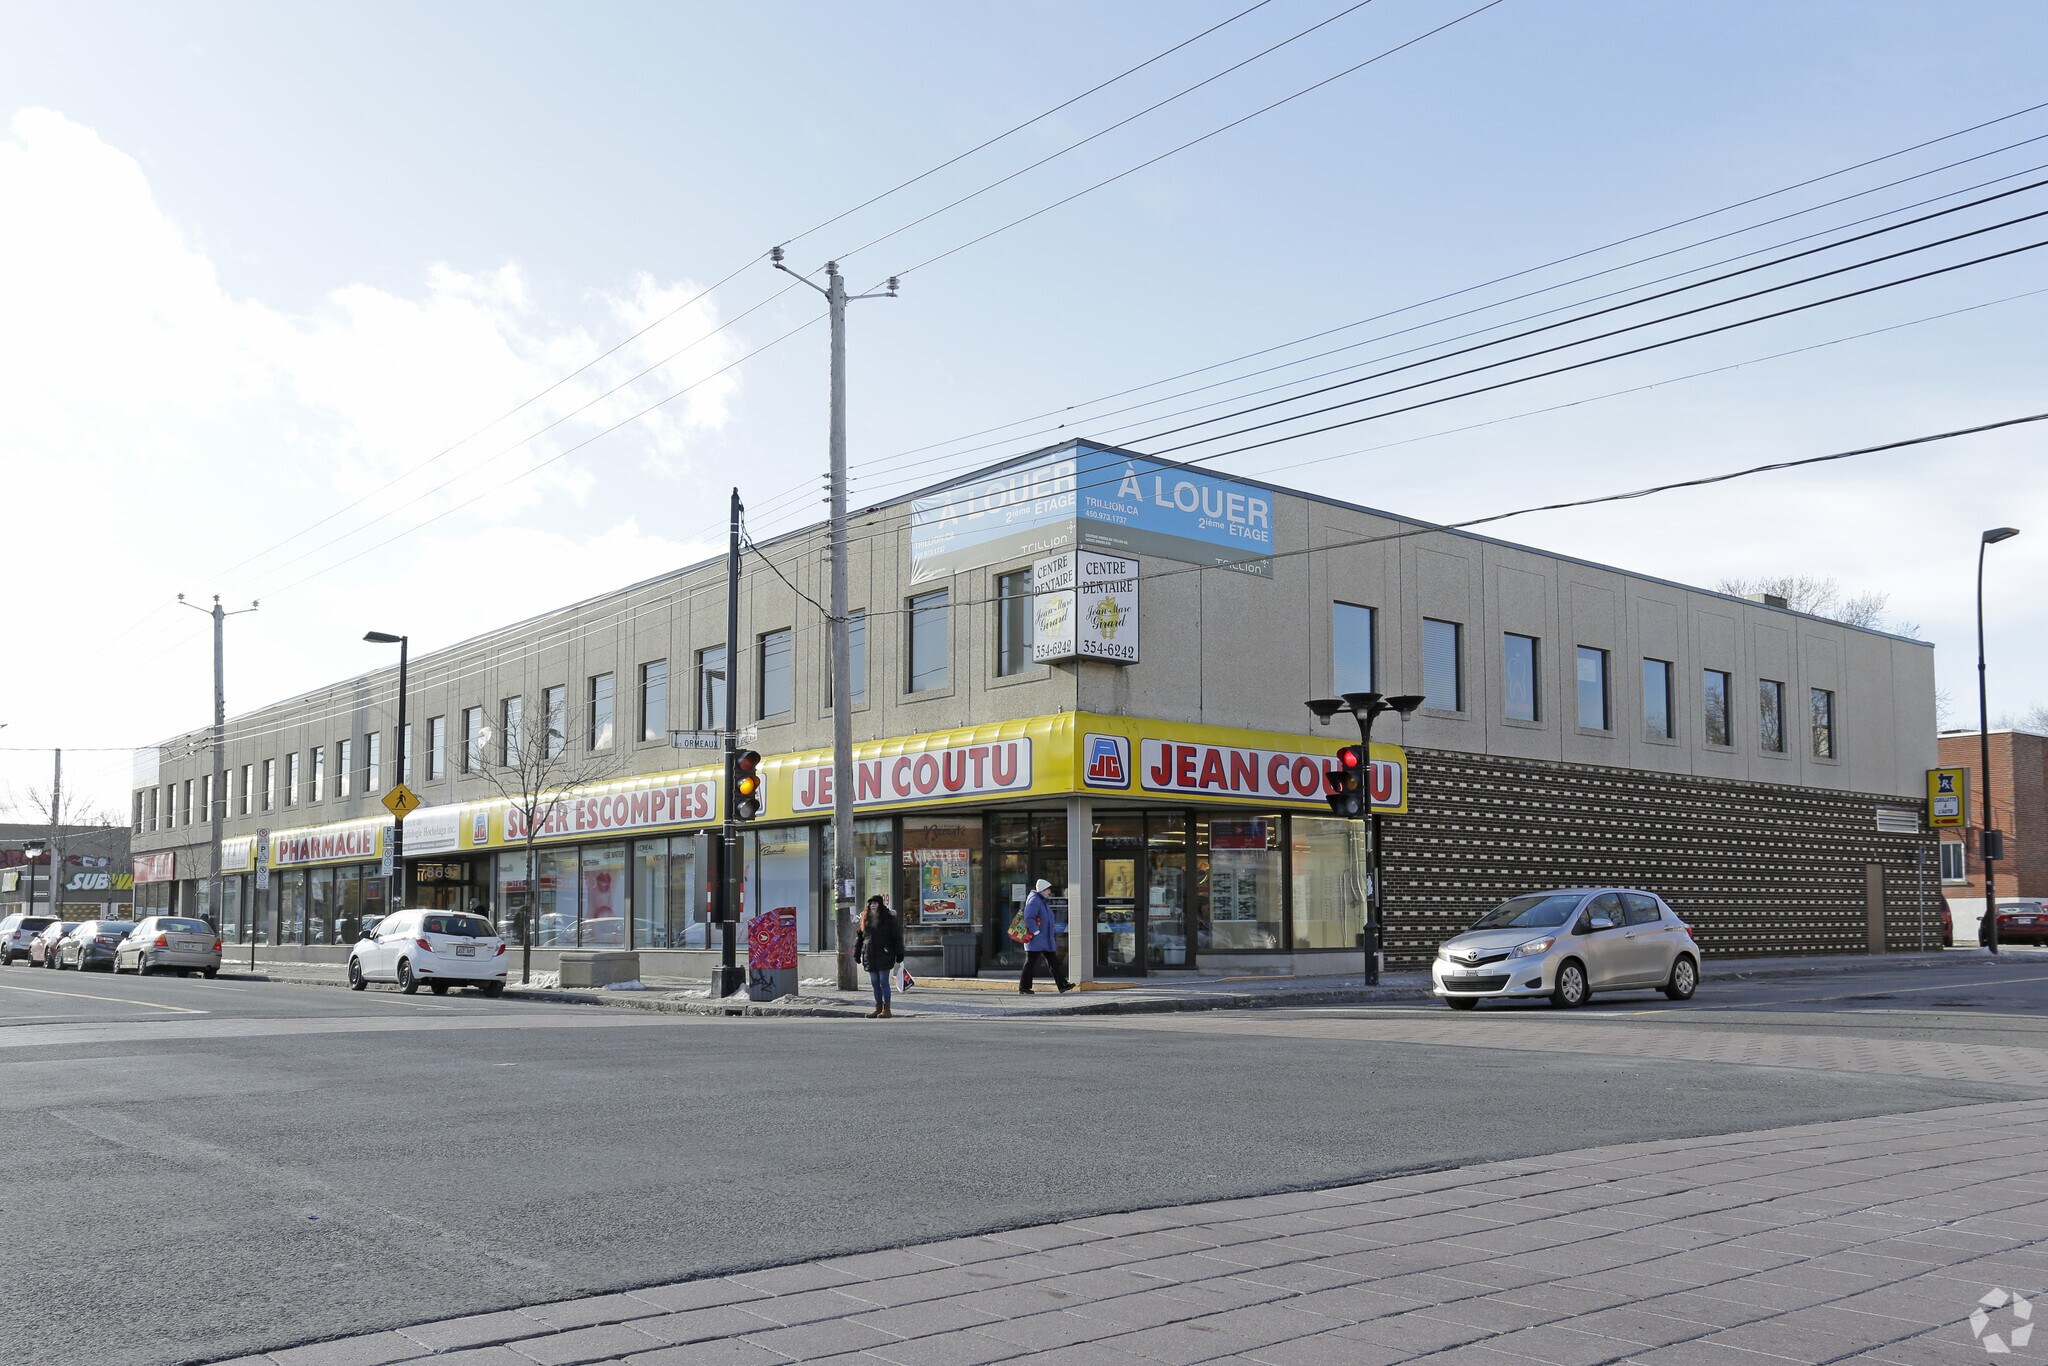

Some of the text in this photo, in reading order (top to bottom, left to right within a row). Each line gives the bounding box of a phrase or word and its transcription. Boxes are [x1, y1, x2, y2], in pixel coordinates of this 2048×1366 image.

[968, 460, 1076, 520] LOUER
[1117, 461, 1269, 529] À LOUER
[1005, 493, 1076, 523] 2ième ÉTAGE
[1085, 496, 1139, 516] TRILLION.CA
[1085, 509, 1127, 524] 450.973.1737
[1198, 518, 1269, 543] 2ième ÉTAGE
[1037, 555, 1068, 579] CENTRE
[1086, 561, 1126, 575] CENTRE
[1035, 569, 1073, 597] DENTAIRE
[1082, 580, 1133, 594] DENTAIRE
[1039, 607, 1069, 631] Girard
[1085, 604, 1131, 620] Jean-Marc
[1090, 614, 1127, 630] Girard
[1035, 639, 1071, 658] 354-6242
[1083, 640, 1134, 659] 354-6242
[684, 739, 718, 748] ORMEAUX
[801, 743, 1018, 807] JEN COUTU
[1151, 743, 1392, 802] JEAN COUU
[508, 783, 708, 838] SUPER ESCOMPTES
[279, 829, 371, 862] PHARMACIE
